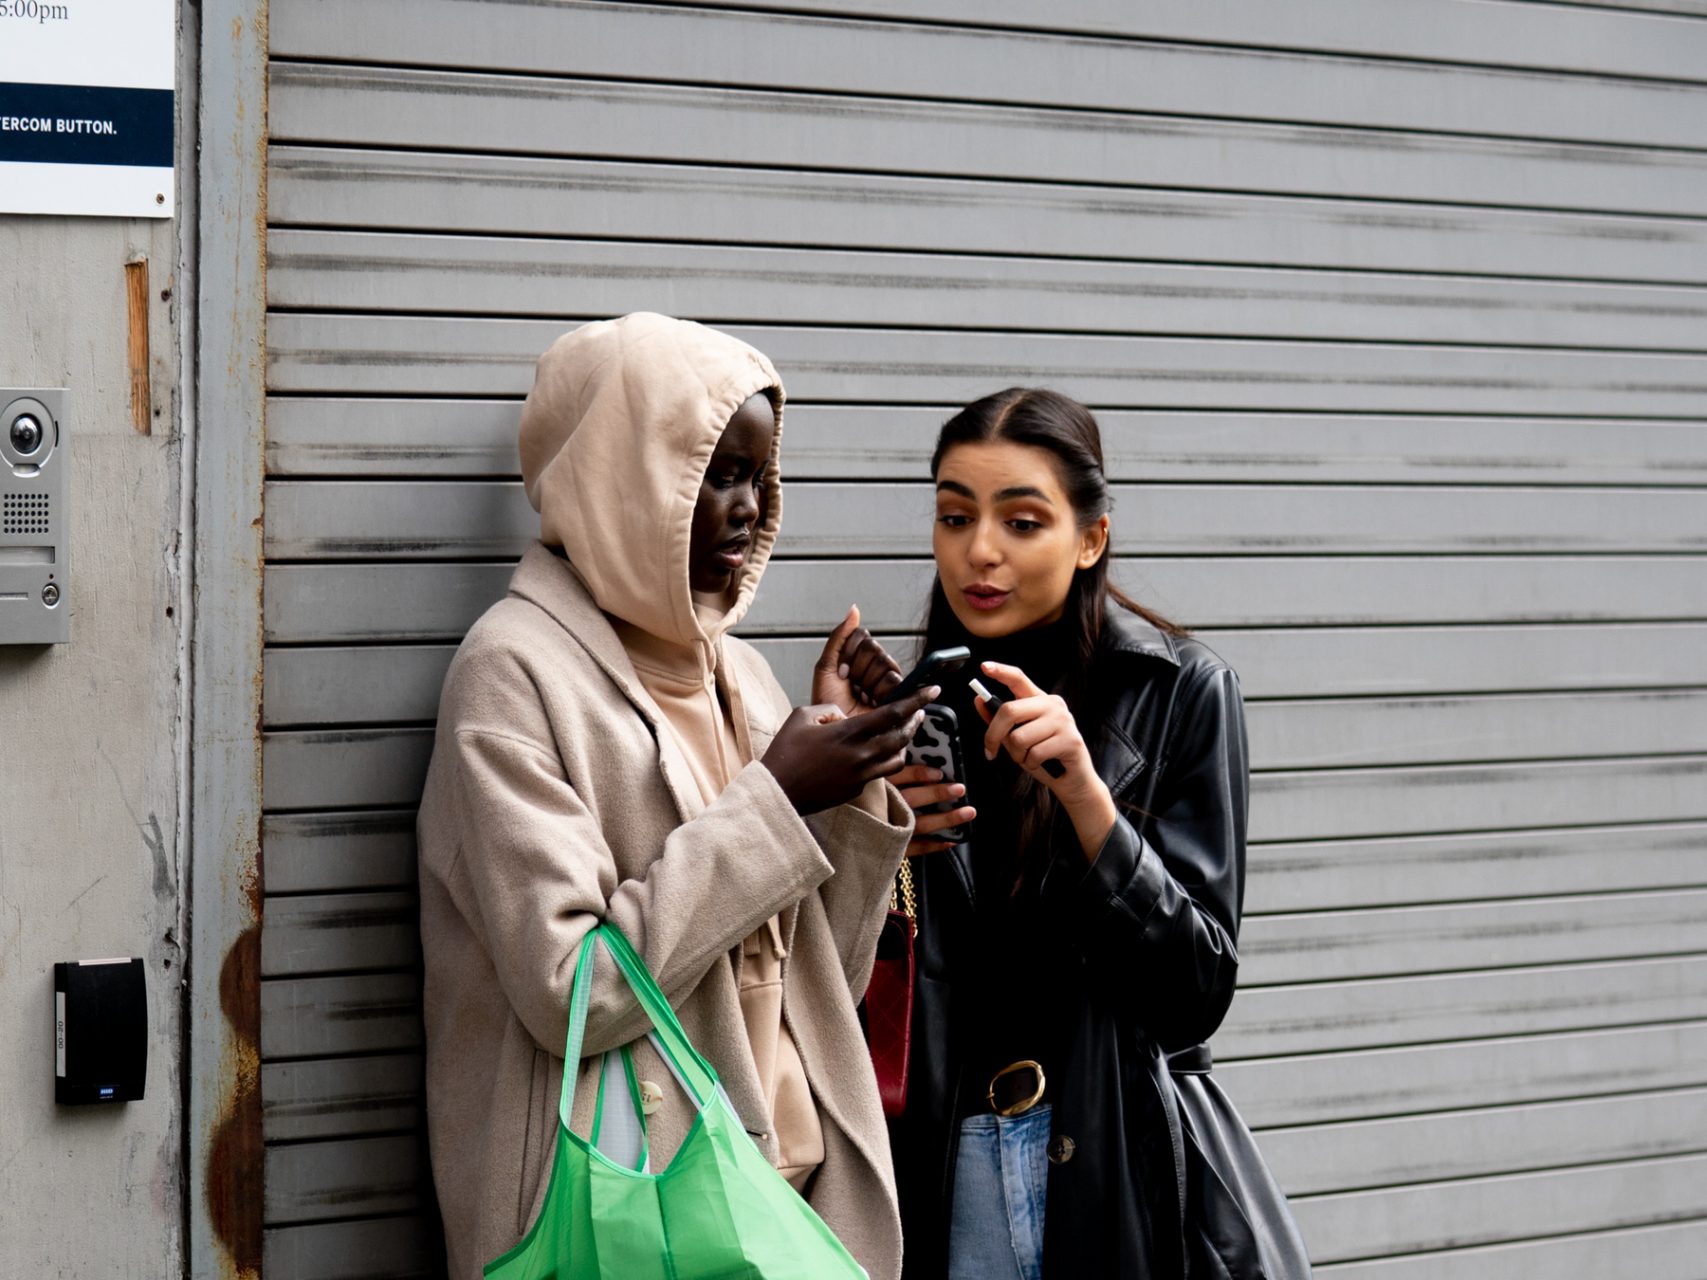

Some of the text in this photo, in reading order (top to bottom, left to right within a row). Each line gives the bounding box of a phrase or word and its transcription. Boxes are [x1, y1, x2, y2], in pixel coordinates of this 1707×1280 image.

[0, 0, 68, 24] 5:00pm
[0, 117, 117, 135] ERCOM BUTTON.
